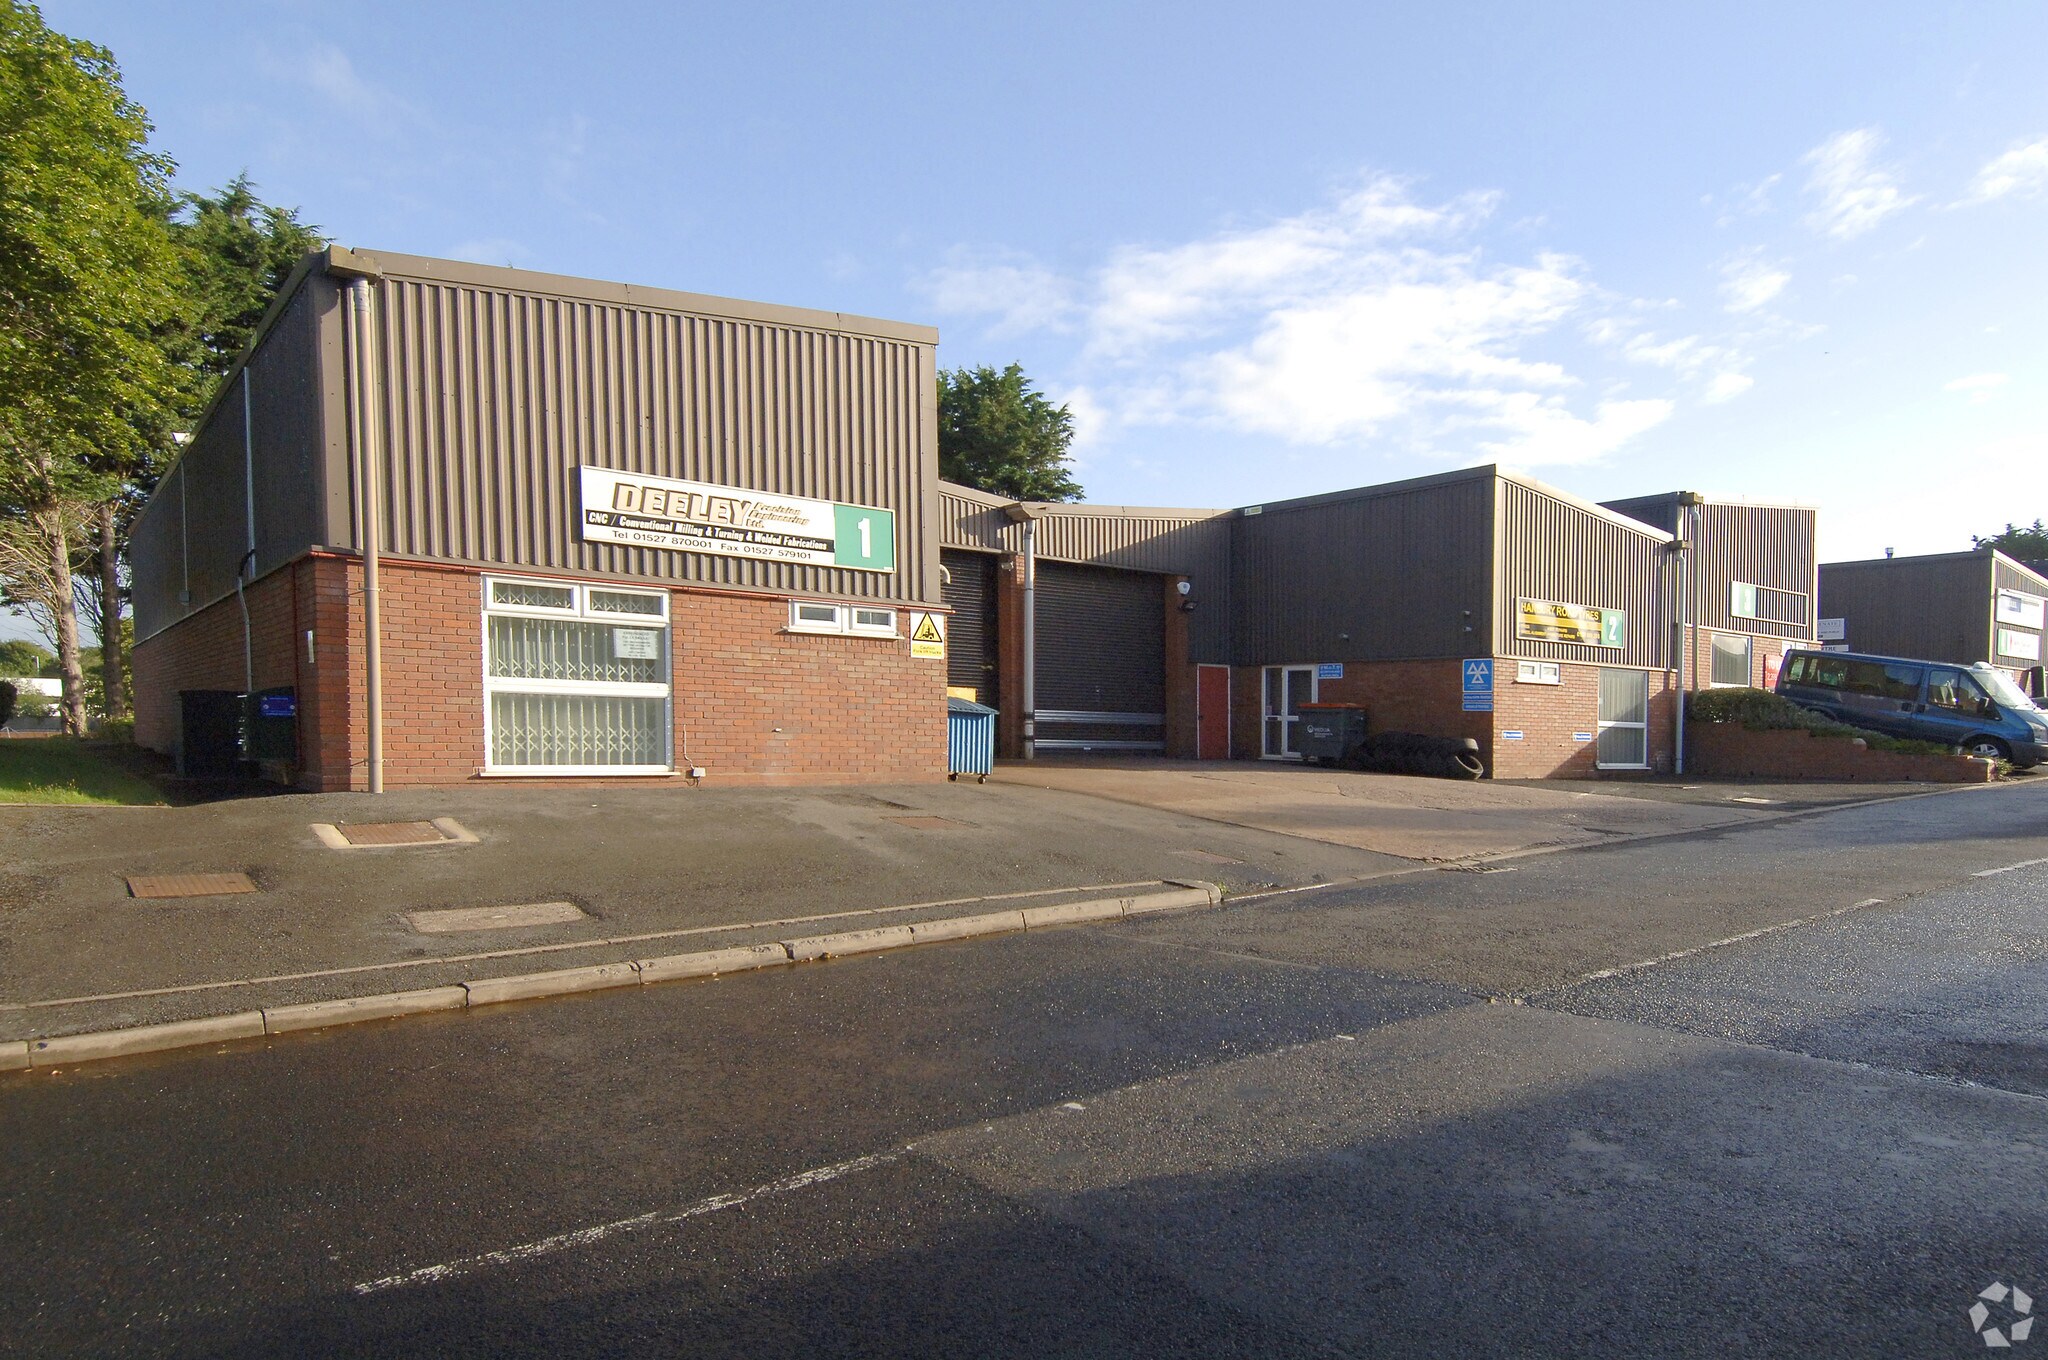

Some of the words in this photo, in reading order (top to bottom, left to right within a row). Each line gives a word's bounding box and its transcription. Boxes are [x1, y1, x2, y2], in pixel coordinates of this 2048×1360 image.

[612, 482, 751, 526] DEELEY
[753, 502, 801, 515] Precision
[745, 519, 764, 528] Ltd.
[748, 510, 809, 525] Engineering
[588, 512, 608, 524] CNC
[610, 514, 617, 526] /
[619, 515, 673, 532] Conventional
[675, 522, 703, 537] Milling
[705, 526, 712, 536] &
[714, 527, 744, 542] Turning
[745, 531, 753, 541] &
[755, 532, 781, 545] Welded
[783, 537, 827, 550] Fabrications
[858, 517, 871, 558] 1
[613, 530, 628, 539] Tel
[633, 533, 666, 543] 01527
[671, 537, 712, 549] 870001
[720, 543, 738, 552] Fax
[744, 546, 774, 555] 01527
[778, 550, 811, 559] 579101
[1521, 601, 1555, 614] HANRY
[1556, 606, 1577, 618] RO
[1744, 588, 1752, 612] 3
[1608, 616, 1618, 641] 2
[1768, 660, 1775, 669] TO
